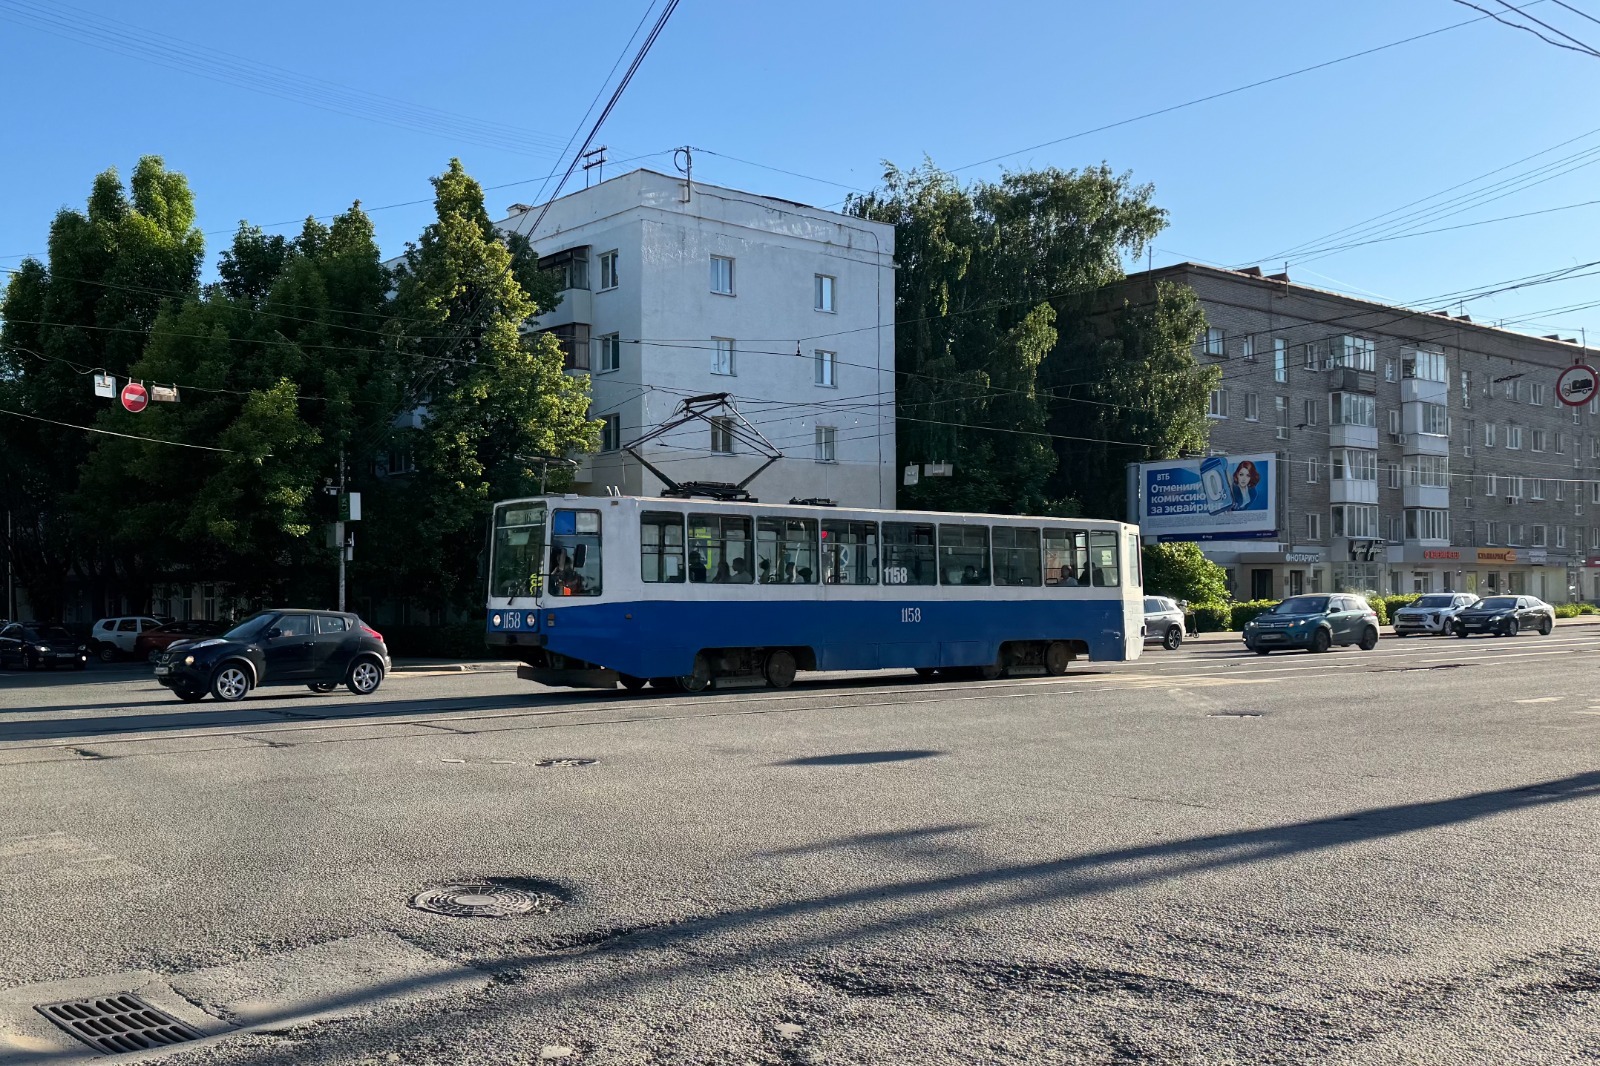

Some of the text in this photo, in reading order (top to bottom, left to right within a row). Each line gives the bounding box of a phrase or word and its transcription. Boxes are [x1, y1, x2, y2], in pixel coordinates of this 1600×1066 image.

[1156, 473, 1171, 481] ВТБ
[1151, 482, 1203, 493] Отменили
[1201, 469, 1227, 501] 0%
[1151, 492, 1207, 504] комиссию
[1150, 505, 1162, 514] за
[1290, 553, 1320, 562] НОТАРИУС
[883, 566, 908, 584] 1158
[503, 612, 521, 629] 1158
[901, 607, 921, 623] 1158
